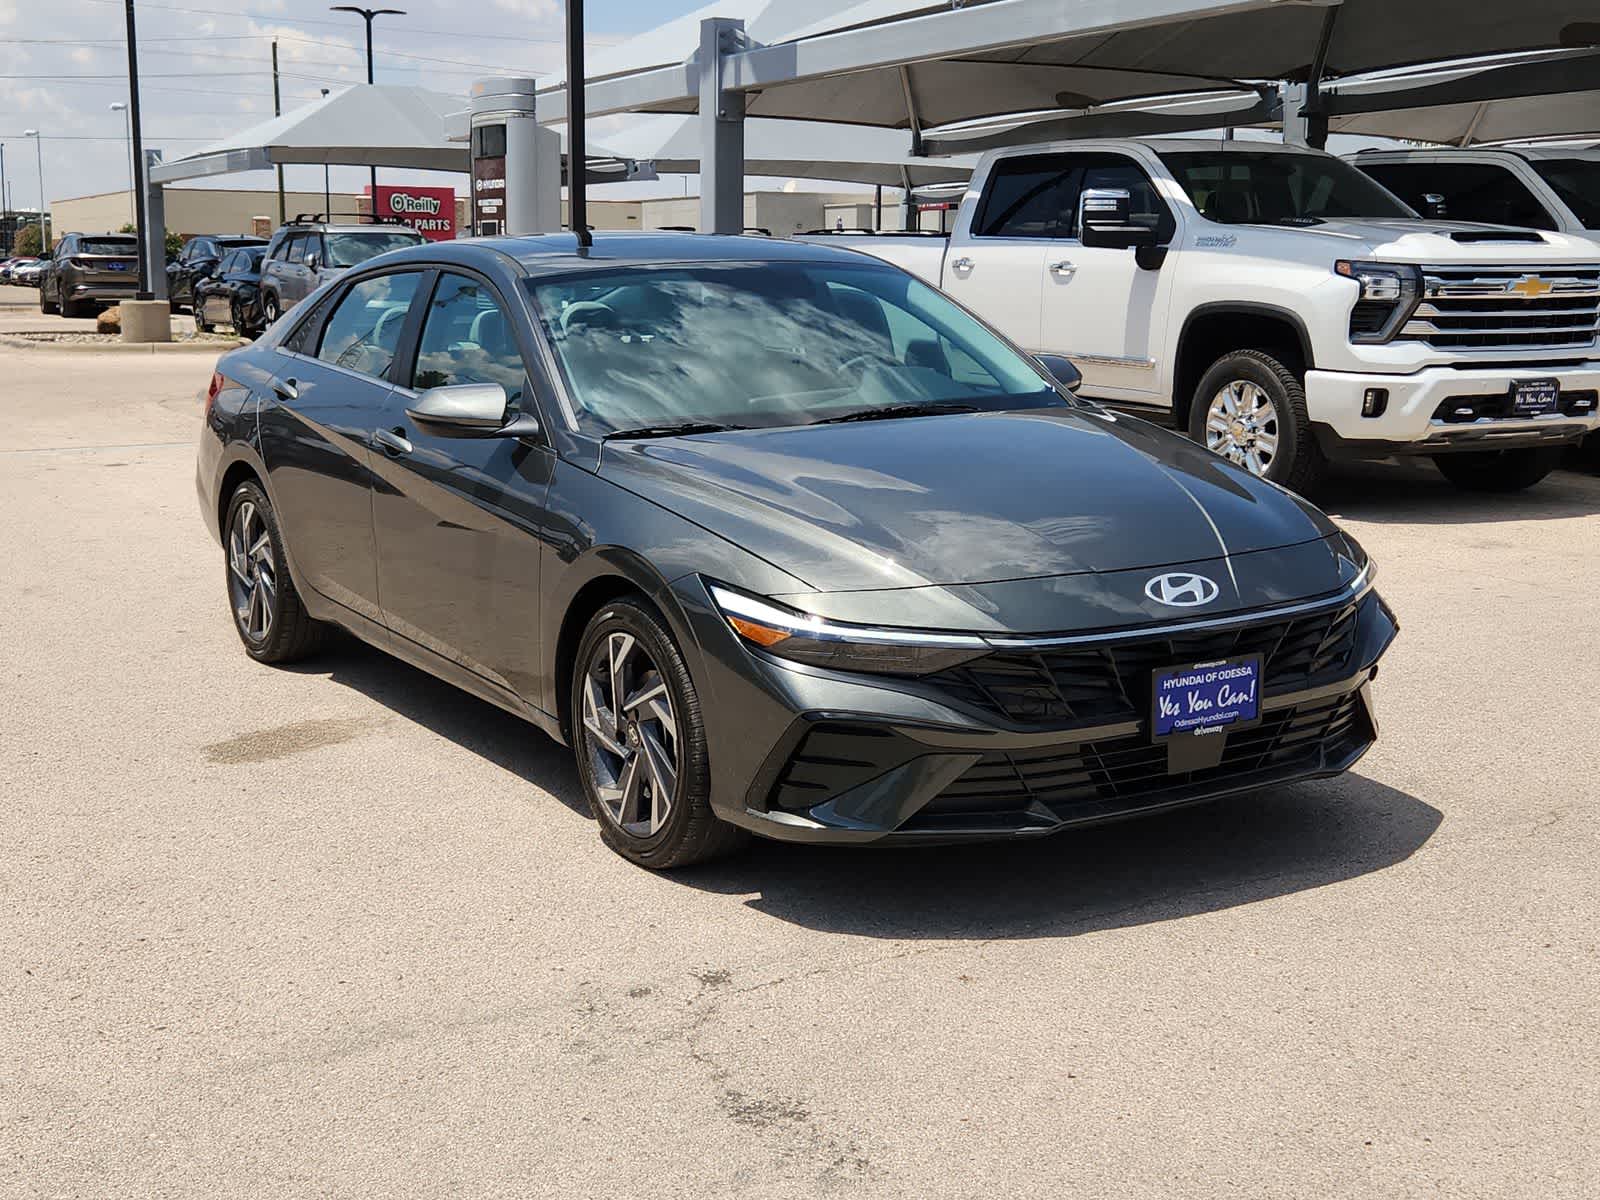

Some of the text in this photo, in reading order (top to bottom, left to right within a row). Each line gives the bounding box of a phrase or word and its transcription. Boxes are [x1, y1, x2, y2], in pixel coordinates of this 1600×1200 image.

[391, 193, 440, 214] O'Reilly
[415, 219, 450, 231] PARTS
[1163, 667, 1252, 689] HYUNDAI OF ODESSA
[1159, 679, 1256, 719] Yes You Can!
